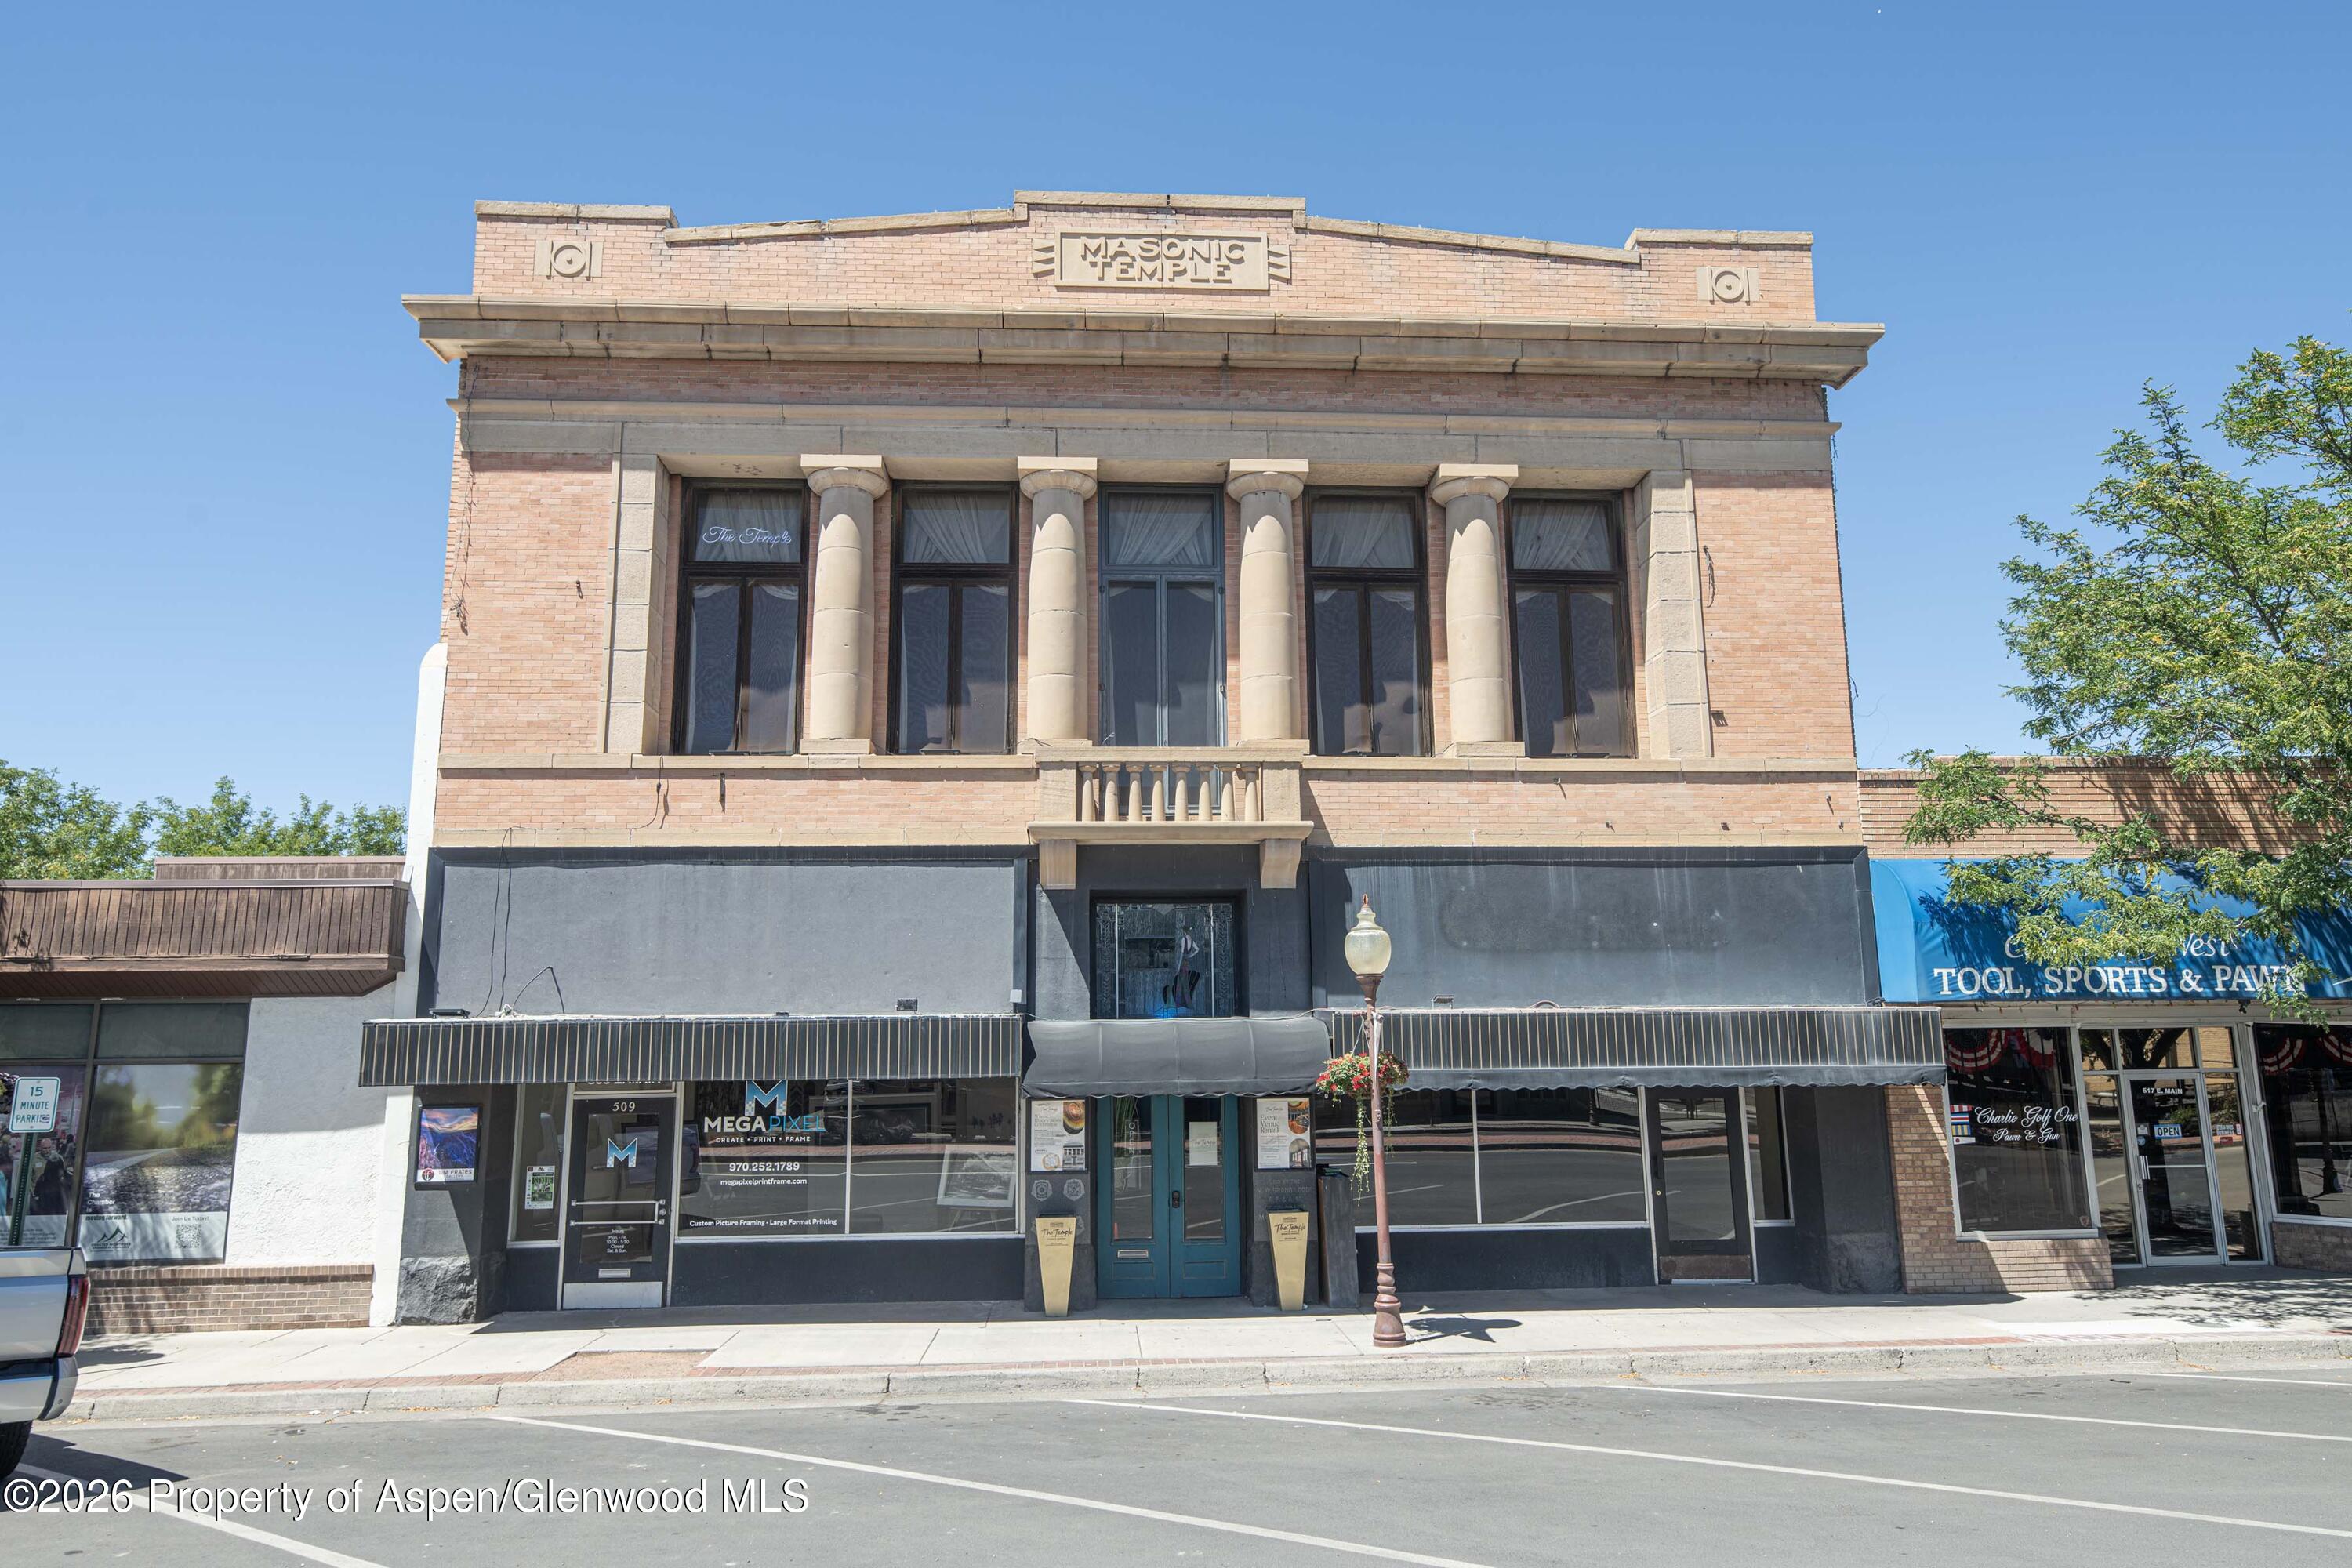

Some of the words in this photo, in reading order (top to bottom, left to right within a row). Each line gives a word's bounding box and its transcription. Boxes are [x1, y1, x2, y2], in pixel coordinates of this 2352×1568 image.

[1080, 236, 1245, 263] MASONIC
[1089, 260, 1232, 282] TEMPLE
[702, 526, 735, 543] The
[739, 527, 792, 549] Temple
[1933, 967, 2031, 998] TOOL,
[2044, 966, 2167, 993] SPORTS
[2179, 968, 2204, 993] &
[31, 1086, 44, 1097] 15
[744, 1080, 789, 1116] M
[20, 1101, 49, 1110] MINUTE
[612, 1102, 636, 1112] 509
[703, 1116, 827, 1133] MEGAPIXEL
[1974, 1106, 2018, 1124] Charlie
[2020, 1105, 2052, 1130] Golf
[2054, 1105, 2079, 1123] One
[1992, 1128, 2021, 1142] Pawn
[2024, 1129, 2037, 1141] &
[2038, 1127, 2060, 1144] Gun
[2157, 1127, 2180, 1137] OPEN
[606, 1137, 637, 1168] M
[729, 1161, 800, 1172] 970.252.1789
[720, 1178, 808, 1187] megapixelprintframe.com
[1041, 1229, 1053, 1238] The
[1053, 1227, 1073, 1238] Temple
[1274, 1223, 1287, 1234] The
[1287, 1223, 1306, 1232] Temple
